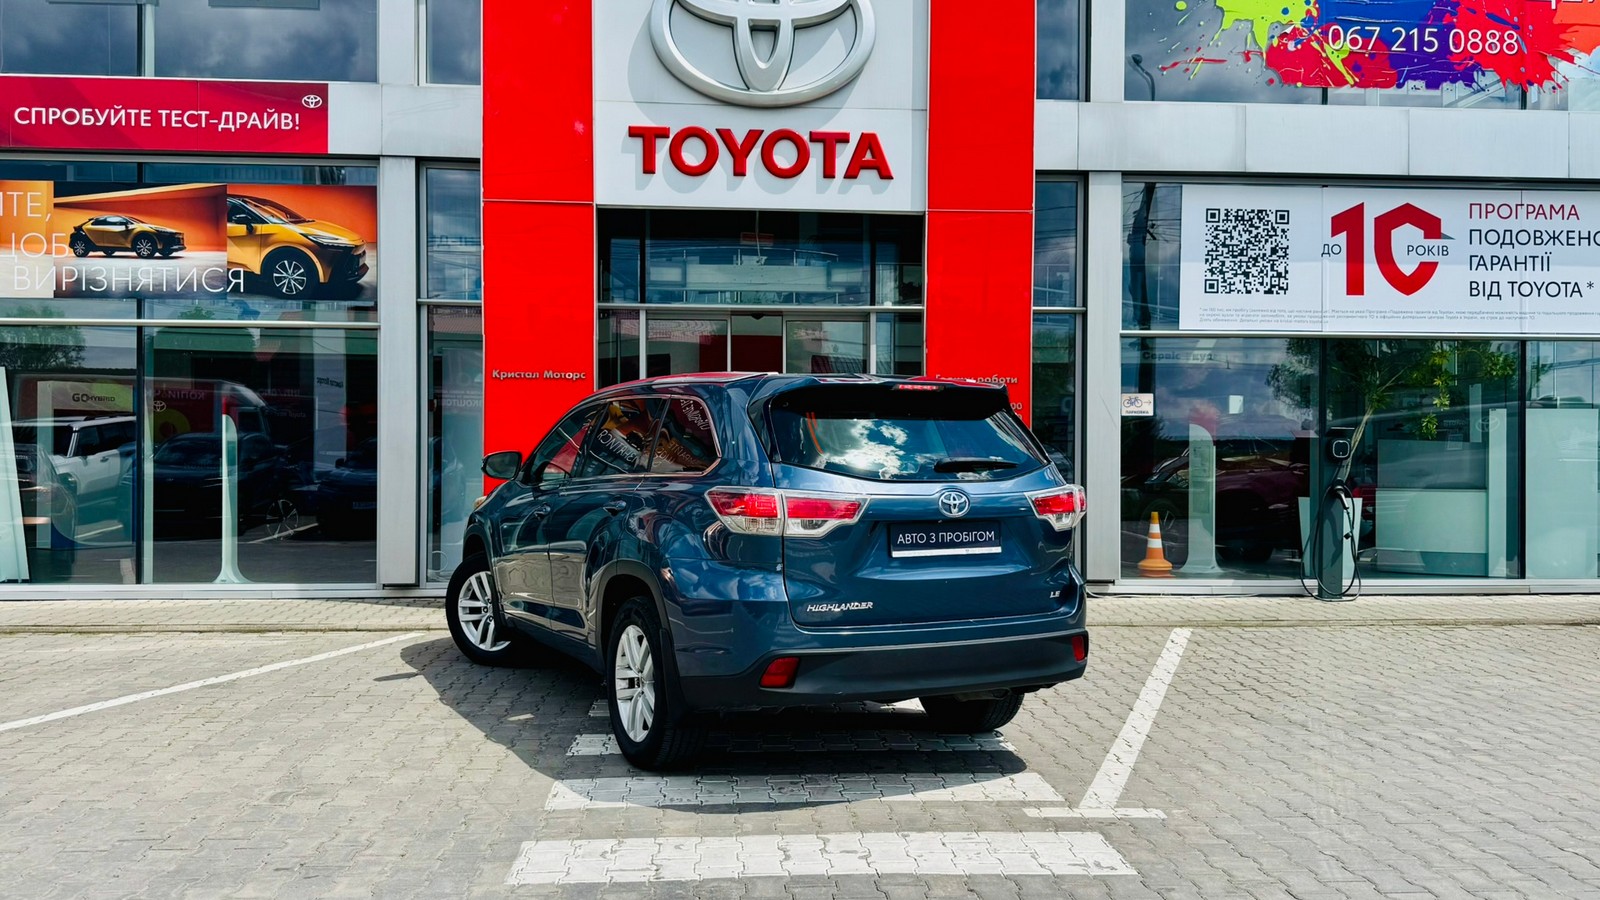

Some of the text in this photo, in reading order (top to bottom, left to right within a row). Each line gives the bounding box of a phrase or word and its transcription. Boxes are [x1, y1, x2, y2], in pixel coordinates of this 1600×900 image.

[1327, 25, 1519, 55] 067 215 0888
[14, 105, 300, 132] СПРОБУЙТЕ ТЕСТ-ДРАЙВ!
[628, 125, 894, 180] TOYOTA
[0, 191, 51, 222] ТЕ,
[1469, 203, 1580, 221] ПРОГРАМА
[1321, 243, 1342, 257] ДО
[1407, 244, 1449, 257] РОКІВ
[1469, 252, 1552, 272] ГАРАНТІЇ
[13, 264, 245, 293] ВИРІЗНЯТИСЯ
[1468, 281, 1502, 301] ВІД
[492, 369, 586, 382] Кристал Моторс
[897, 531, 995, 545] АВТО З ПРОБІГОМ
[807, 601, 874, 612] HIGHLANDER
